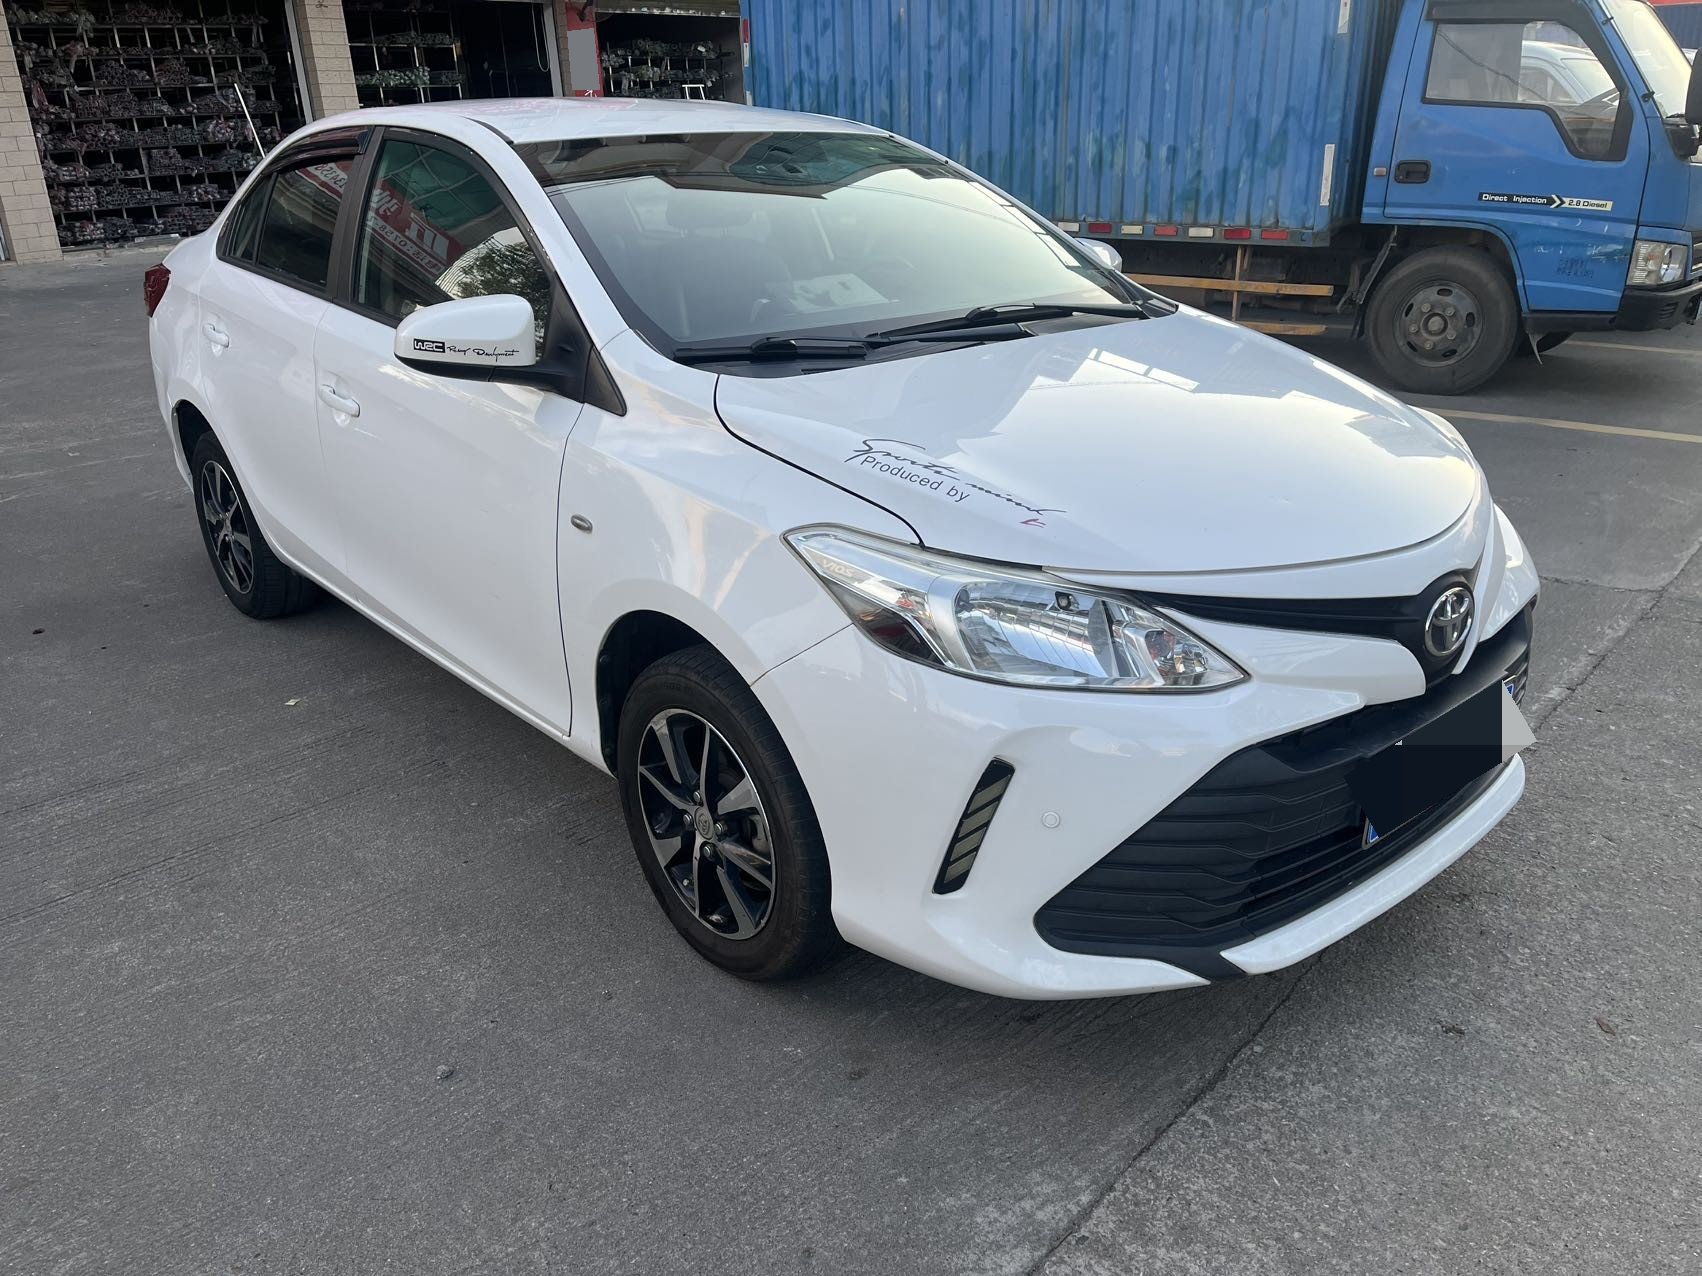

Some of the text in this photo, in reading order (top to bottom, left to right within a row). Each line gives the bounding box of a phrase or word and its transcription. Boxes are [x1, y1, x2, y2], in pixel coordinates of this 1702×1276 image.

[1482, 193, 1608, 209] Direct Injection 2.8 Diesel
[415, 340, 444, 353] WRC
[860, 455, 970, 503] Produced by
